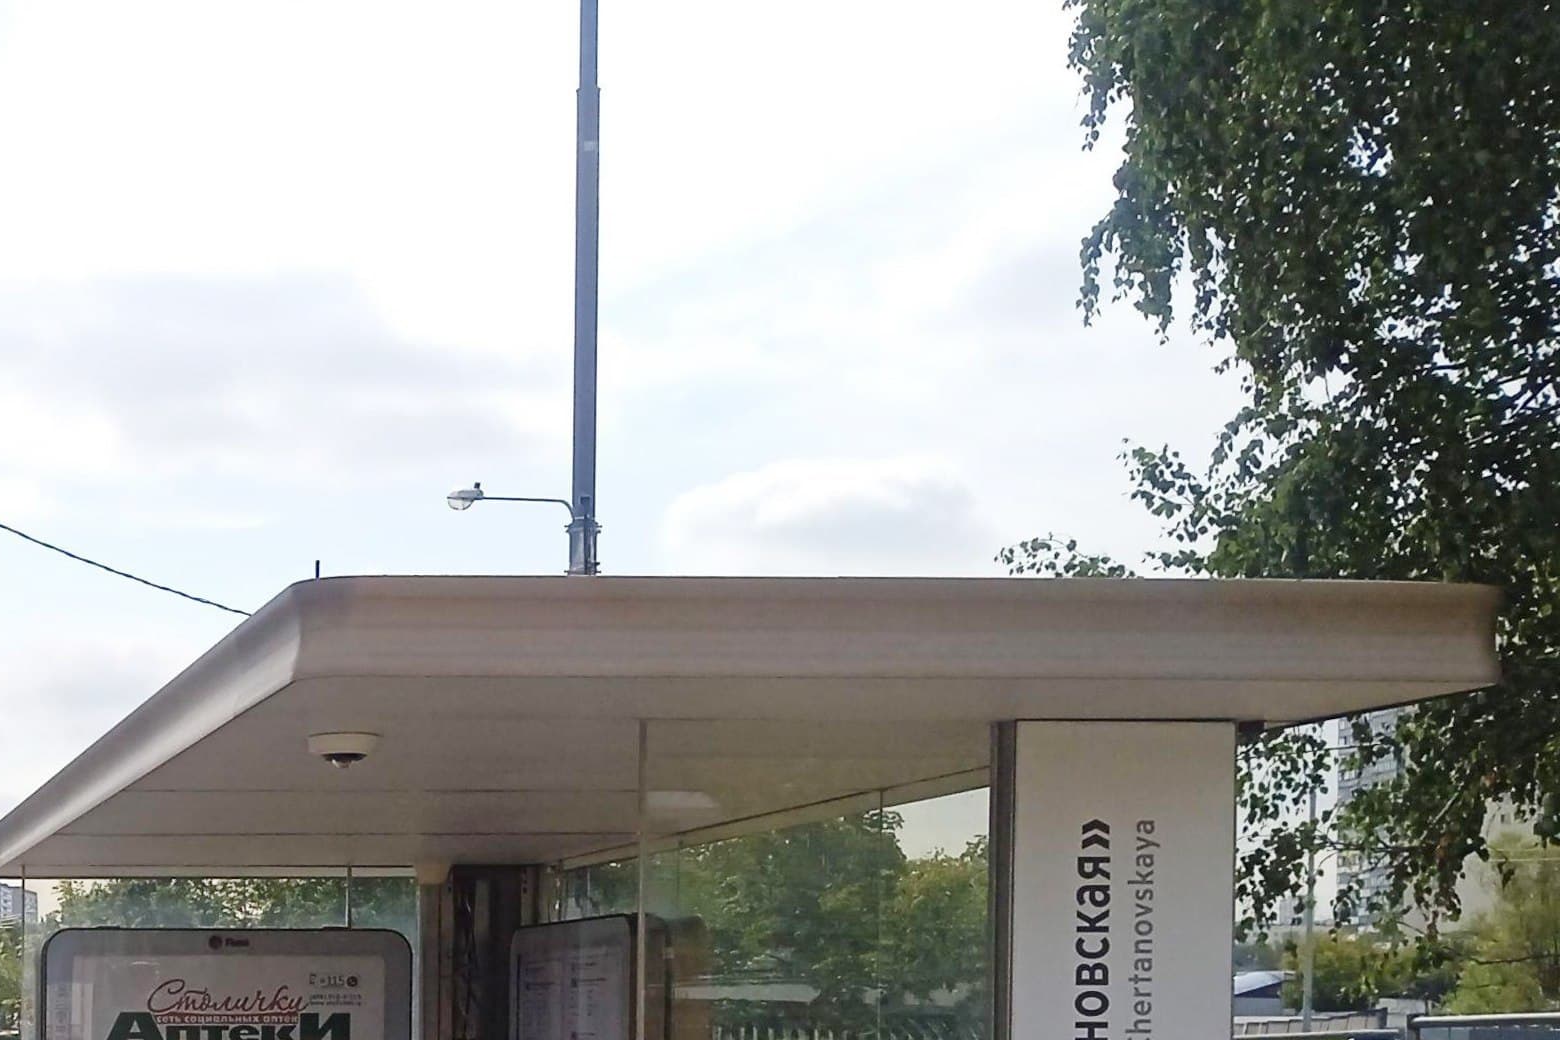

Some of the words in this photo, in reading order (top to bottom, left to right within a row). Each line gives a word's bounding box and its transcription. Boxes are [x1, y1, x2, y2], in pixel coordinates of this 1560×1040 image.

[147, 978, 310, 1013] Столички
[157, 1014, 181, 1024] сеть
[184, 1014, 260, 1024] социальных
[263, 1014, 299, 1024] аптек
